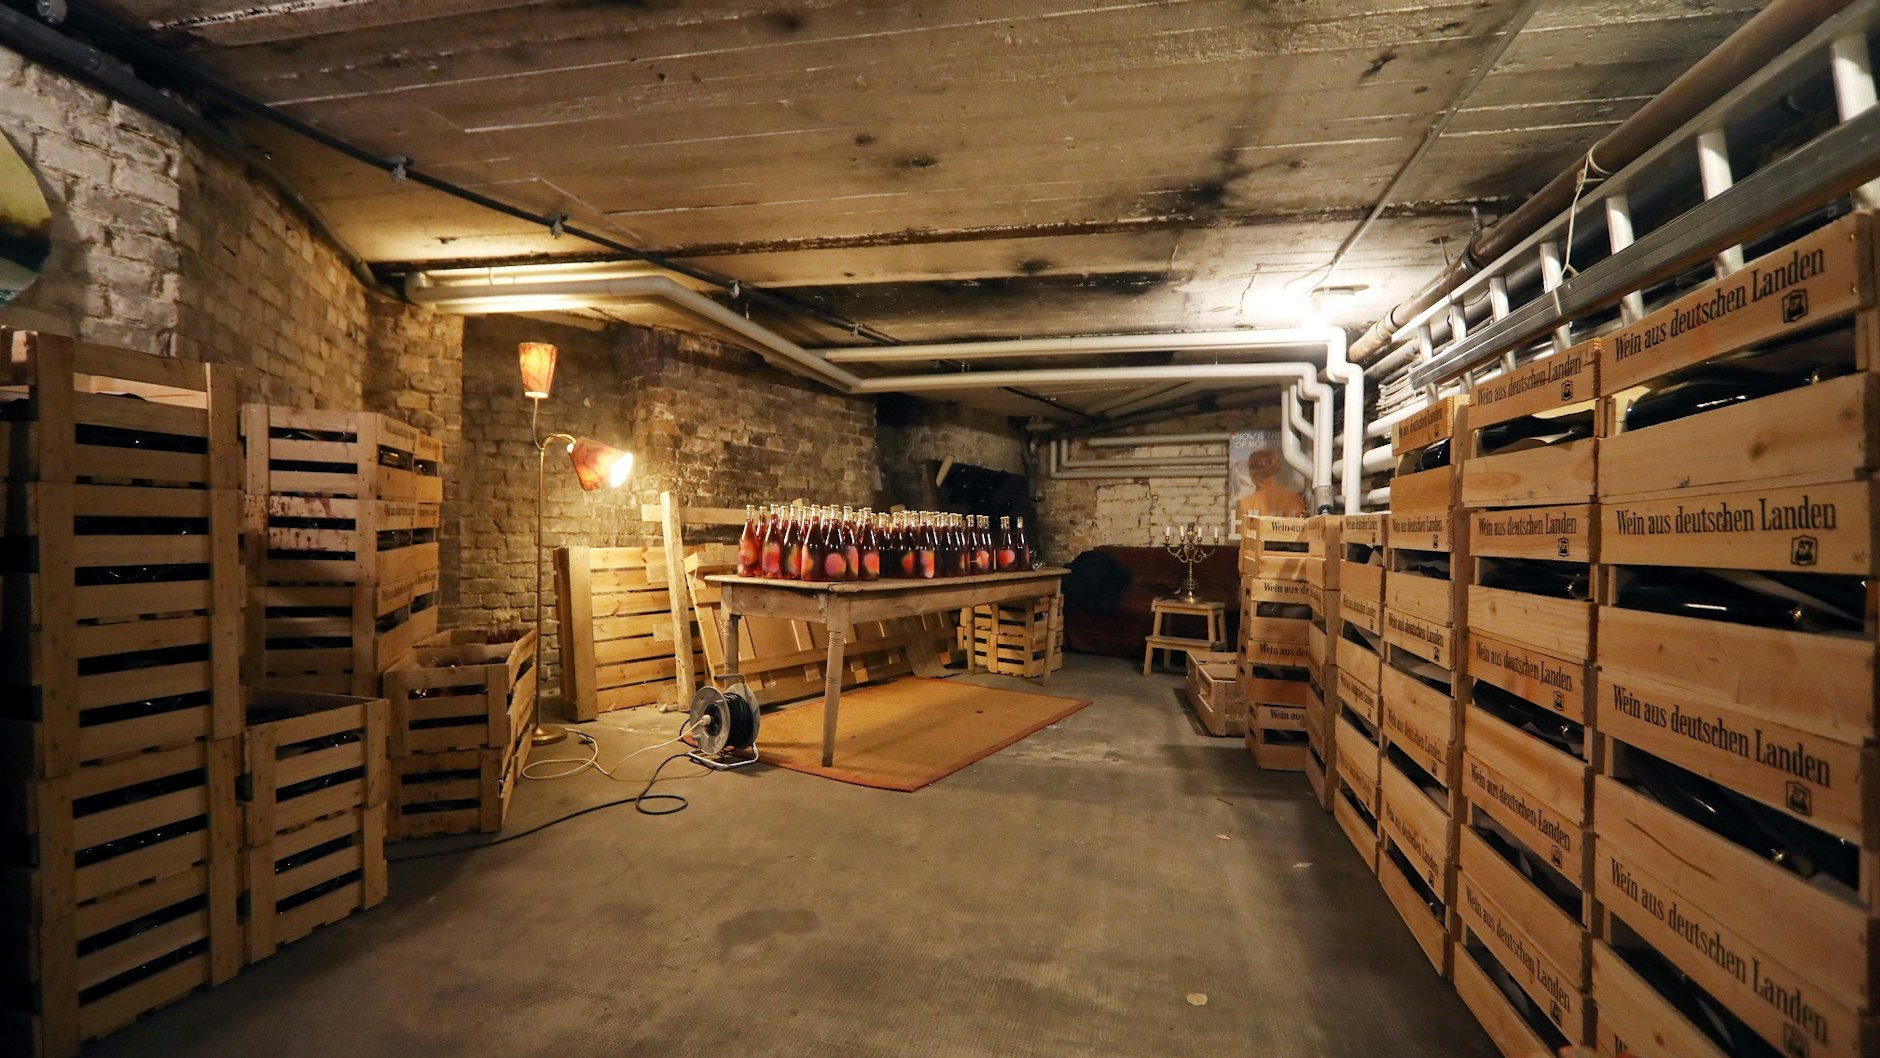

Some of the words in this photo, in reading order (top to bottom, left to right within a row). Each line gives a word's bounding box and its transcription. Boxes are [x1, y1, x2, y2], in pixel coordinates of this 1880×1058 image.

[1614, 332, 1641, 362] Wein
[1644, 321, 1667, 350] aus
[1671, 285, 1746, 338] deutschen
[1751, 249, 1825, 302] Landen
[1477, 387, 1493, 407] Wein
[1495, 383, 1507, 402] aus
[1508, 369, 1545, 396] deutschen
[1548, 354, 1581, 383] Landen
[1272, 522, 1290, 532] Wein
[1479, 518, 1493, 536] Wein
[1494, 521, 1506, 536] aus
[1507, 515, 1543, 536] deutschen
[1545, 512, 1577, 535] Landen
[1616, 509, 1645, 535] Wein
[1648, 513, 1671, 535] aus
[1675, 502, 1755, 533] deutschen
[1758, 495, 1837, 531] Landen
[1264, 582, 1283, 593] Wein
[1284, 585, 1299, 594] aus
[1259, 643, 1279, 655] Wein
[1280, 648, 1294, 656] aus
[1476, 640, 1490, 662] Wein
[1491, 649, 1502, 667] aus
[1504, 650, 1539, 680] deutschen
[1540, 660, 1572, 691] Landen
[1270, 709, 1289, 720] Wein
[1290, 712, 1305, 721] aus
[1612, 684, 1641, 719] Wein
[1644, 702, 1667, 728] aus
[1671, 704, 1749, 758] deutschen
[1755, 728, 1831, 788] Landen
[1471, 763, 1485, 790] Wein
[1487, 780, 1499, 799] aus
[1500, 784, 1536, 828] deutschen
[1538, 808, 1570, 852] Landen
[1466, 886, 1482, 918] Wein
[1483, 908, 1495, 932] aus
[1497, 919, 1534, 975] deutschen
[1536, 957, 1570, 1013] Landen
[1611, 857, 1639, 902] Wein
[1642, 888, 1664, 921] aus
[1668, 902, 1746, 984] deutschen
[1752, 957, 1828, 1045] Landen
